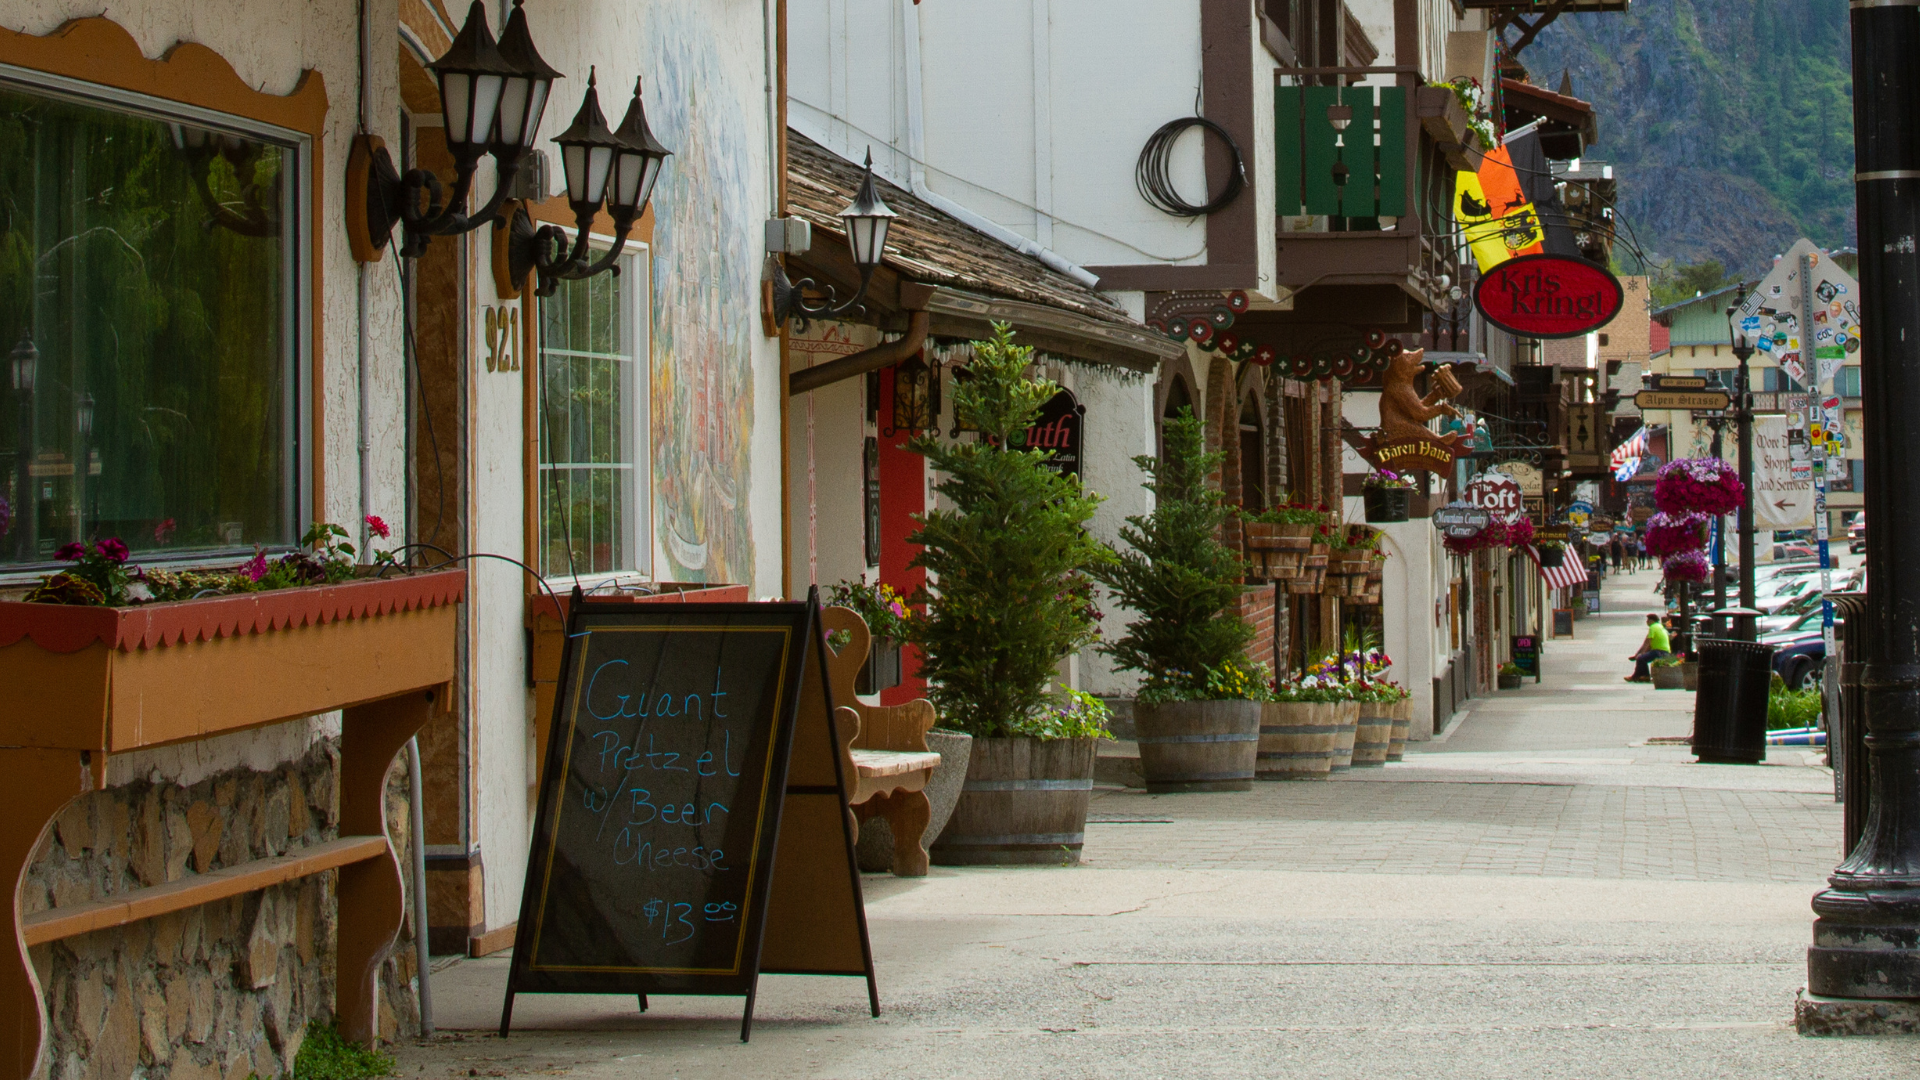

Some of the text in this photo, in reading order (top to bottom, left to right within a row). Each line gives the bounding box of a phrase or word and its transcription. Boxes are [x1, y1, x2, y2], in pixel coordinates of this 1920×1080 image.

[1501, 268, 1561, 293] Kris
[1512, 291, 1603, 320] Kringl
[485, 305, 520, 373] 921
[1817, 329, 1832, 341] COL
[1645, 394, 1719, 406] Alpen Strasse
[1053, 453, 1076, 462] Latin
[1377, 441, 1452, 463] Bären Haus
[1763, 455, 1790, 472] Shopp
[1759, 478, 1774, 491] and
[1472, 488, 1517, 509] Loft
[1436, 511, 1487, 530] Mountain Country
[1450, 525, 1472, 536] Corner
[1517, 638, 1531, 648] OPEN
[586, 659, 728, 721] Giant
[592, 729, 741, 777] Pretzel
[583, 776, 730, 842] w/ Beer
[613, 827, 730, 872] Cheese
